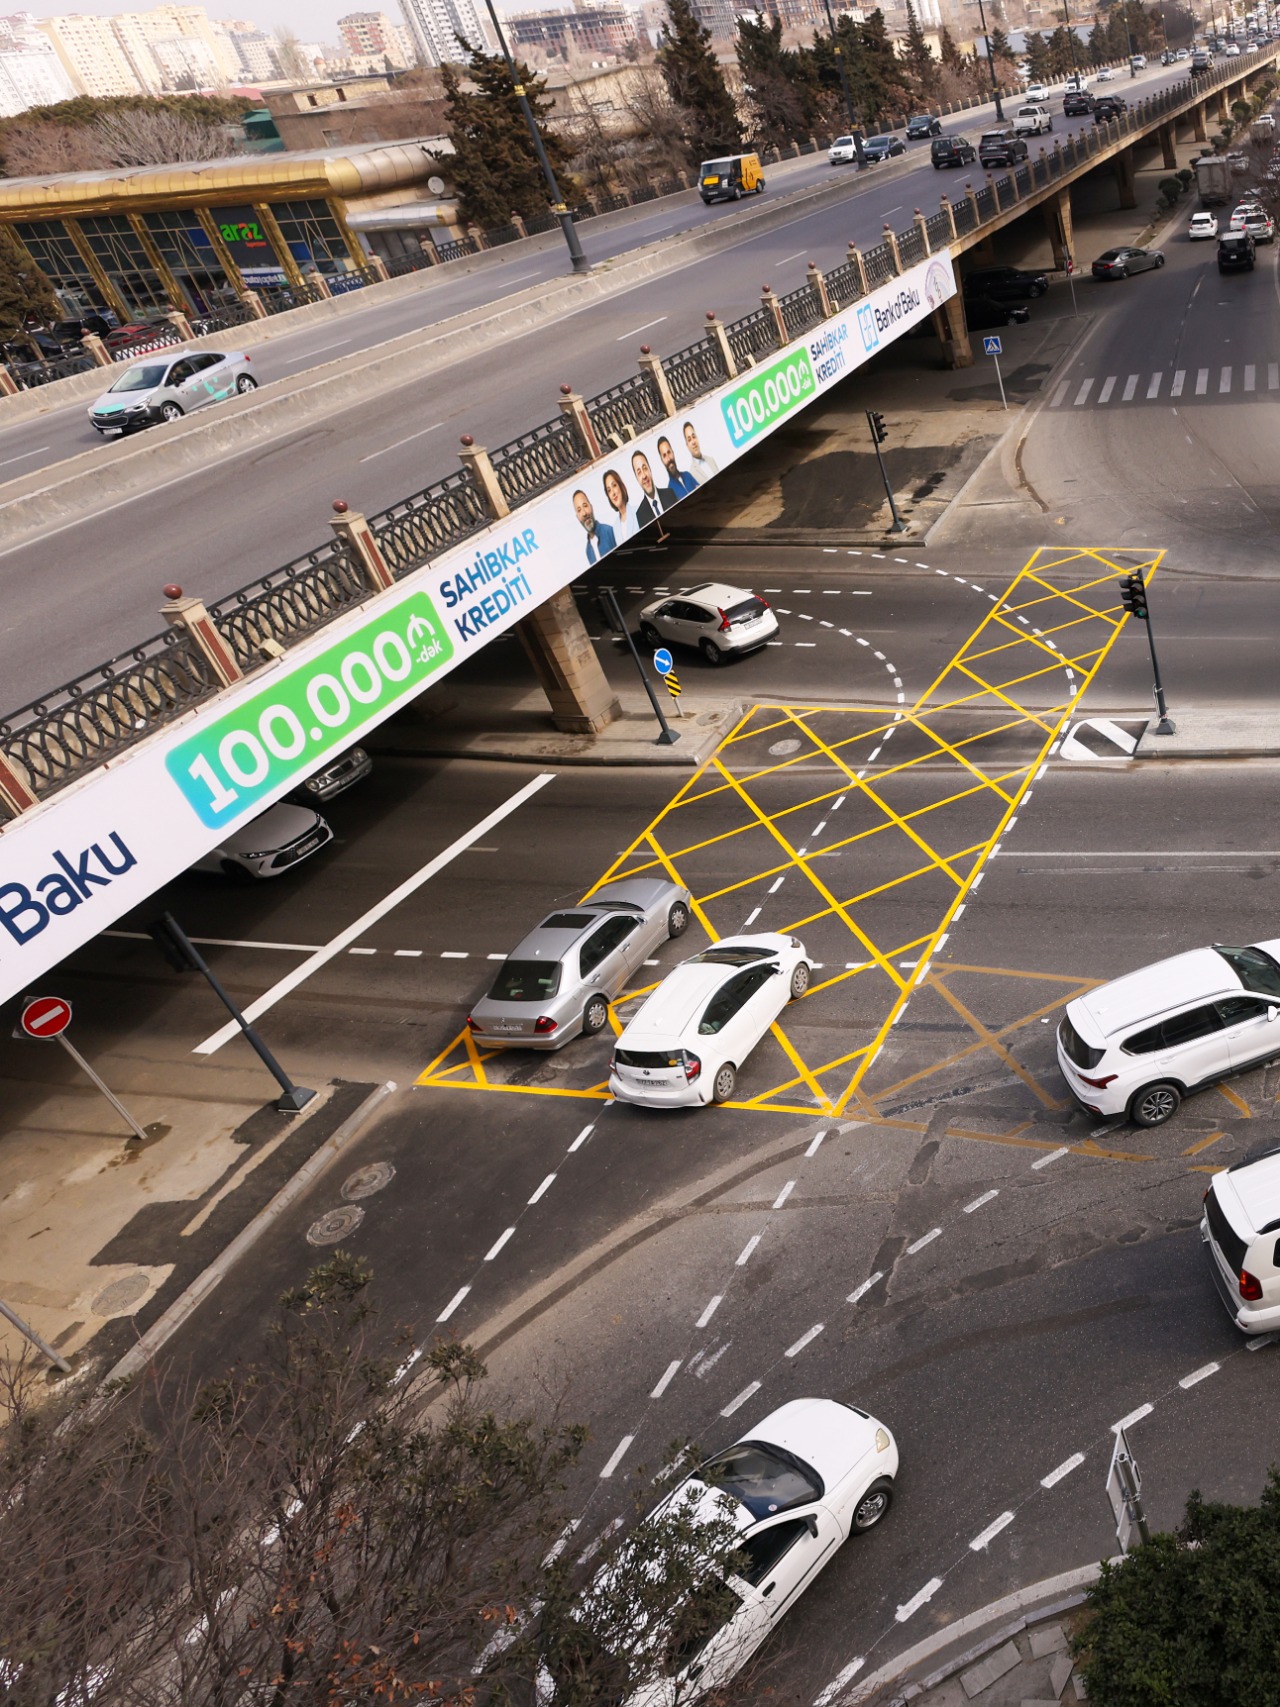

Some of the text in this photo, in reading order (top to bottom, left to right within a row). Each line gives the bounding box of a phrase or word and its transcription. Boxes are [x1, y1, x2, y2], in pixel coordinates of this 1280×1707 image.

[220, 223, 263, 242] araz
[874, 287, 920, 332] Bank of Baku
[810, 323, 848, 361] SAHİBKAR
[815, 350, 846, 384] KREDİTİ
[439, 528, 540, 608] SAHİBKAR
[454, 567, 533, 643] KREDİTİ
[0, 830, 138, 947] Baku
